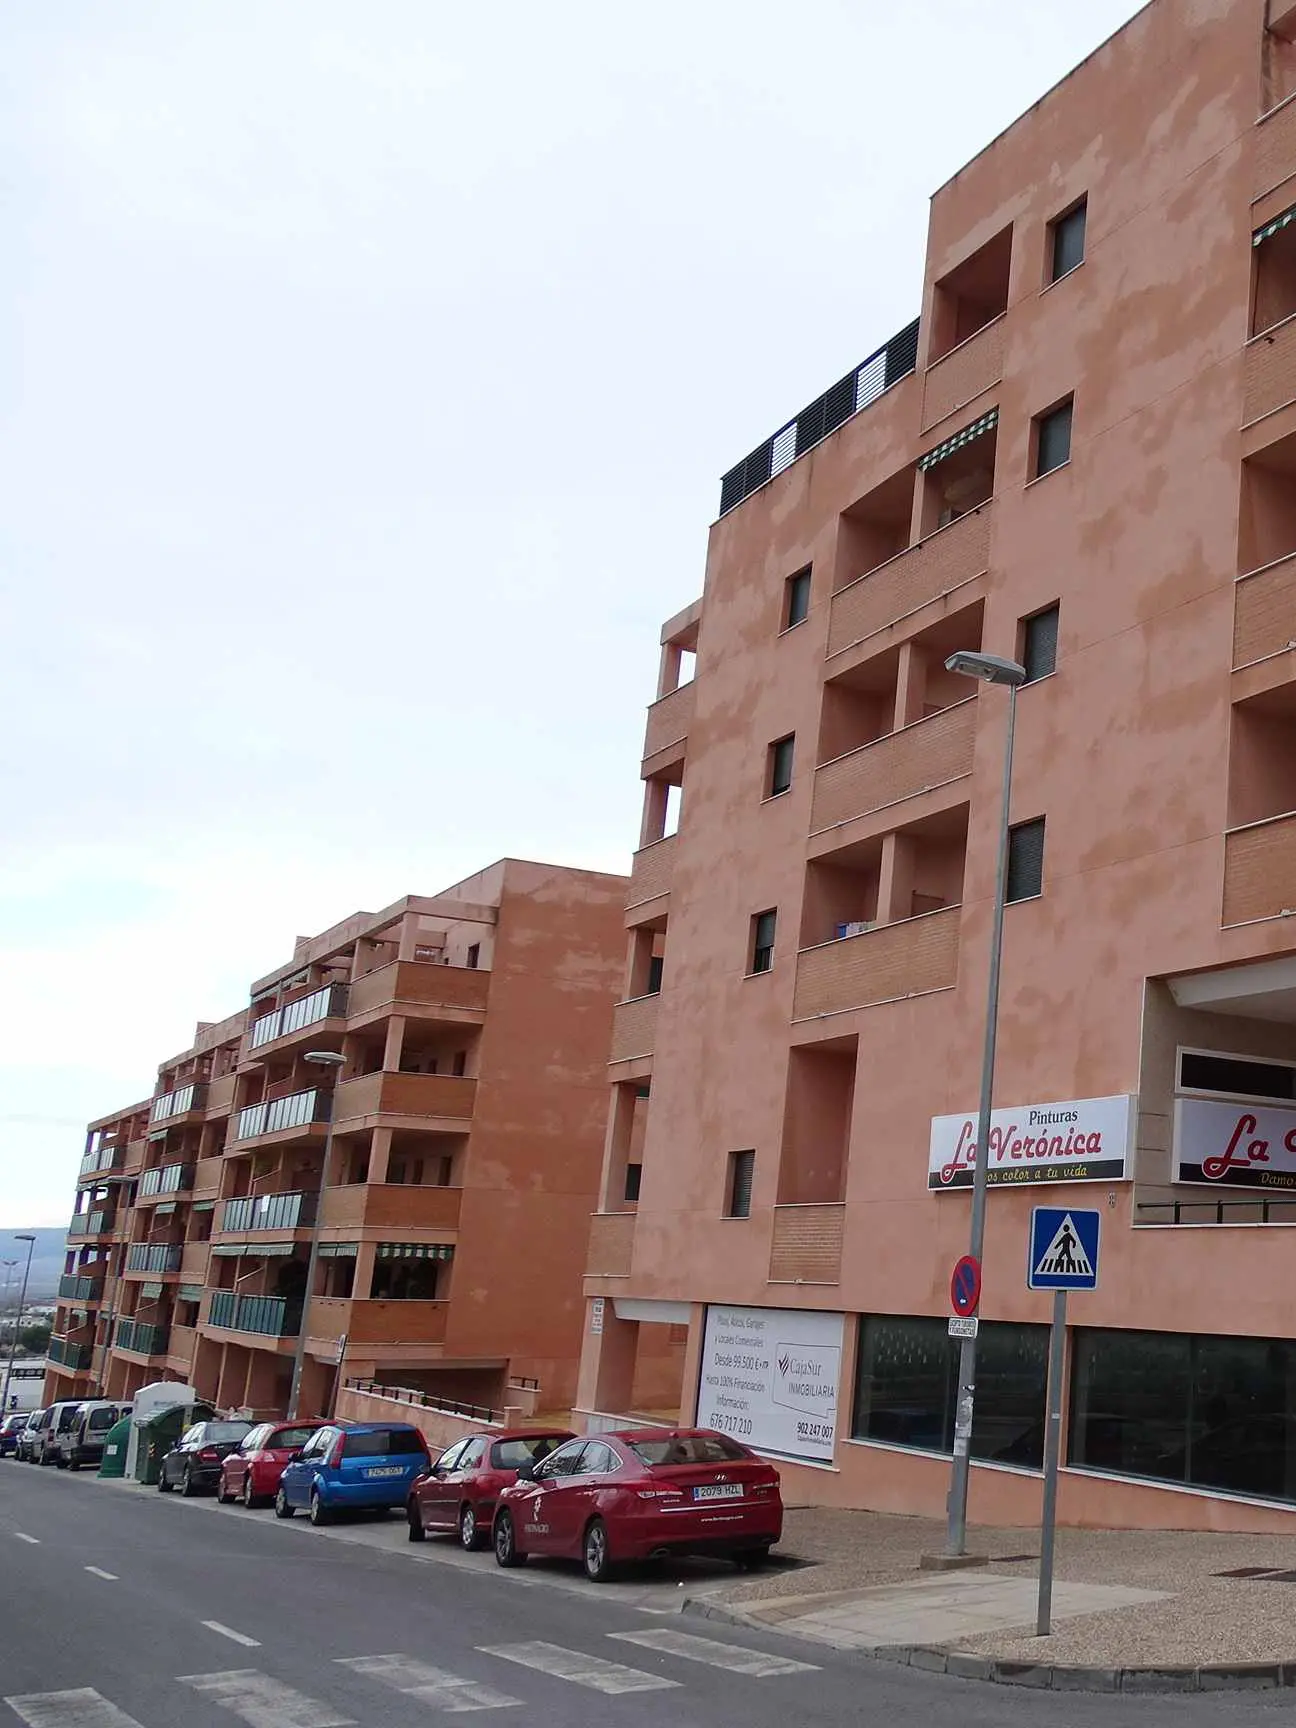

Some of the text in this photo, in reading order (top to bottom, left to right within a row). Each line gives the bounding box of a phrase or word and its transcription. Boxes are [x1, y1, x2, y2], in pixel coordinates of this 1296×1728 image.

[1029, 1109, 1078, 1126] Pinturas
[989, 1126, 1102, 1161] Verónica
[1202, 1113, 1270, 1180] La
[1002, 1167, 1030, 1181] color
[1035, 1170, 1041, 1179] a
[1047, 1166, 1058, 1178] tu
[1063, 1163, 1087, 1177] vida
[714, 1353, 732, 1367] Desde
[790, 1358, 821, 1377] CajaSur
[788, 1383, 835, 1398] INMOBILIARIA
[711, 1413, 752, 1435] 676 717 210
[797, 1422, 833, 1438] 902 247 007
[701, 1487, 722, 1497] 2079
